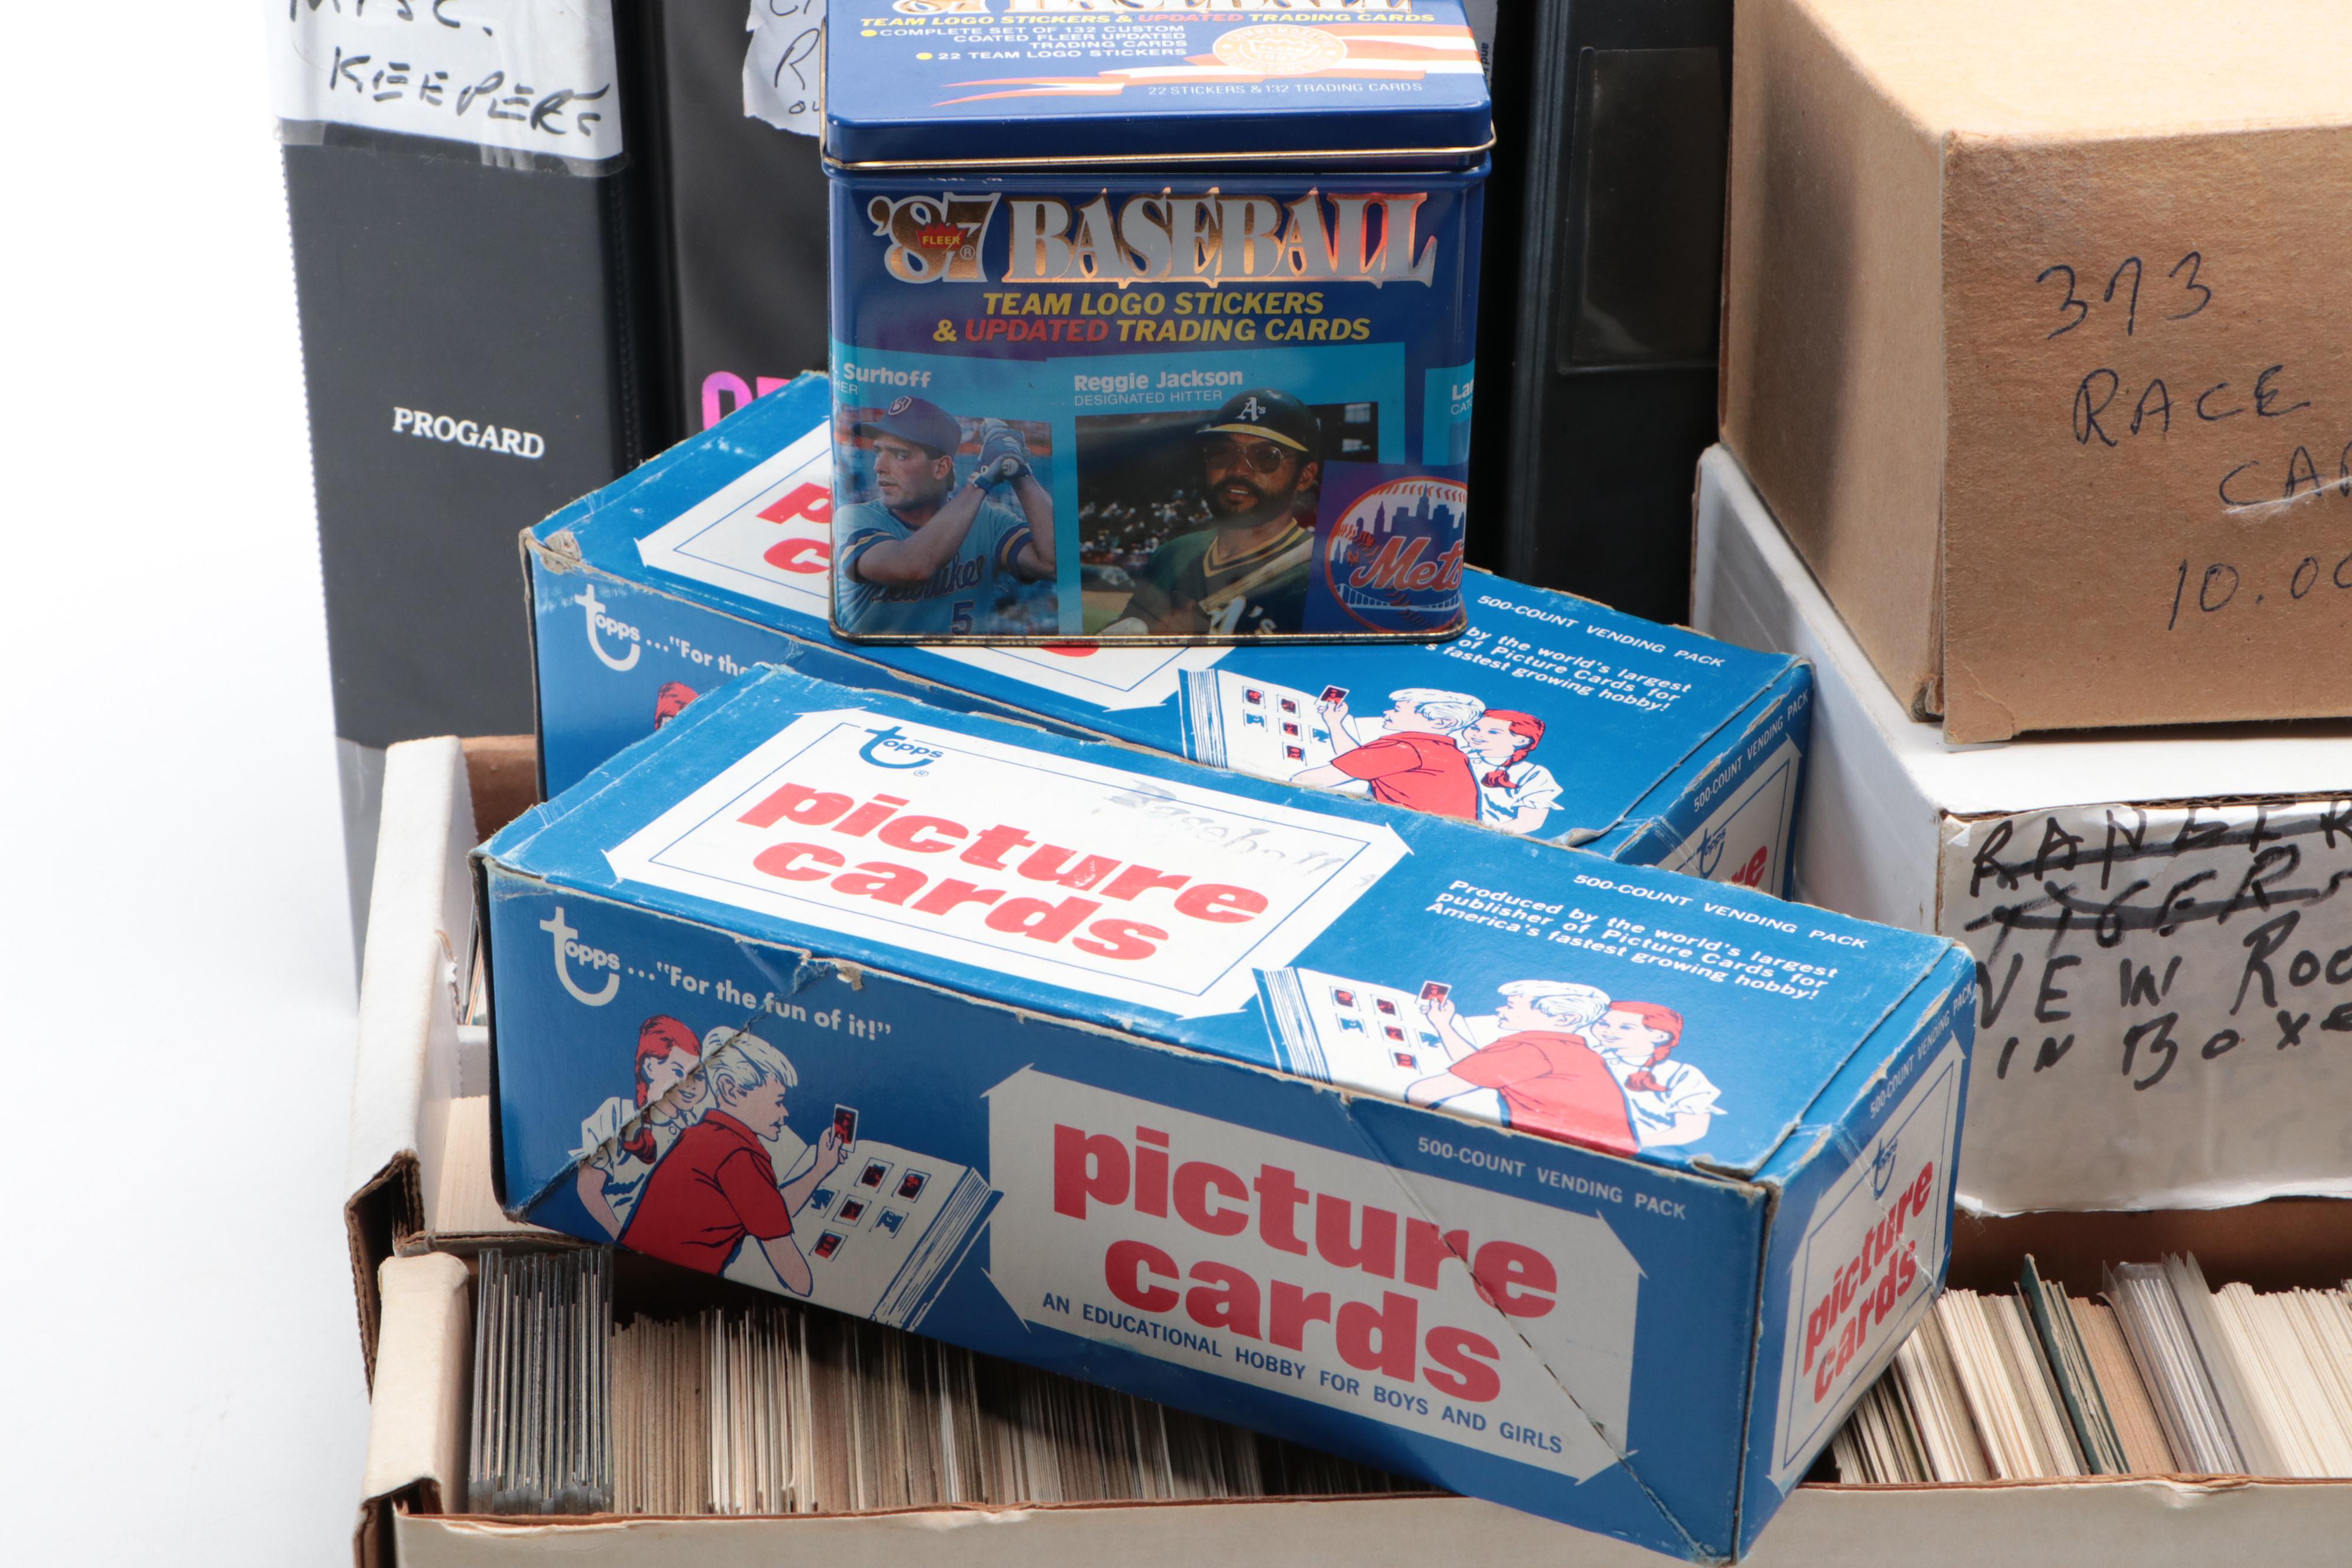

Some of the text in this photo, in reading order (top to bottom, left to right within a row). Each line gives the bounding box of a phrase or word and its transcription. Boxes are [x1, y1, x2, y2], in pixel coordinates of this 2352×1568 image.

[861, 14, 1436, 27] TEAM LOGO STICKERS & UPDATED TRADING CARDS
[880, 27, 982, 37] COMPLETE
[1103, 25, 1185, 33] CUSTOM
[953, 32, 1186, 43] COATED FLEER UPDATED
[1027, 50, 1082, 58] LOGO
[1089, 48, 1188, 57] STICKERS
[1030, 41, 1116, 49] TRADING
[1148, 86, 1167, 96] 22
[1171, 85, 1245, 95] STICKERS
[1266, 84, 1290, 93] 132
[1294, 83, 1364, 93] TRADING
[1368, 83, 1423, 92] CARDS
[922, 235, 961, 246] FLEER
[1001, 187, 1438, 289] BASEBALL
[933, 318, 1372, 342] & UPDATED TRADING CARDS
[983, 292, 1325, 316] TEAM LOGO STICKERS
[843, 362, 932, 388] Surhoff
[1074, 370, 1243, 394] Reggie Jackson
[1074, 390, 1223, 407] DESIGNATED HITTER
[2073, 365, 2311, 447] RACE
[392, 406, 545, 459] PROGARD
[1349, 535, 1465, 592] Mets
[575, 584, 641, 671] topps
[1466, 626, 1693, 693] by the world's largest
[1477, 595, 1727, 668] 500-COUNT VENDING PACK
[1443, 645, 1671, 712] fastest growing hobby!
[1458, 638, 1484, 650] of
[1490, 646, 1568, 674] Picture
[1574, 669, 1636, 692] Cards
[1647, 687, 1681, 702] for
[859, 726, 945, 769] topps
[1694, 689, 1809, 812] 500-COUNT VENDING PACK
[736, 782, 1269, 924] picture
[753, 842, 1170, 961] cards
[1449, 880, 1839, 978] Produced by the world's largest
[1573, 874, 1869, 949] 500-COUNT VENDING PACK
[540, 907, 620, 1007] topps
[716, 979, 757, 1010] the
[765, 994, 807, 1023] fun
[814, 1008, 841, 1031] of
[1425, 902, 1819, 1000] America's fastest growing hobby!
[1435, 892, 1829, 988] publisher of Picture Cards for
[1870, 981, 1972, 1119] 500-COUNT VENDING PACK
[1417, 1137, 1687, 1220] 500-COUNT VENDING PACK
[1054, 1123, 1558, 1318] picture
[1803, 1161, 1933, 1377] picture
[1105, 1240, 1501, 1403] cards
[1814, 1240, 1917, 1404] cards
[1043, 1292, 1563, 1454] AN EDUCATIONAL HOBBY FOR BOYS AND GIRLS
